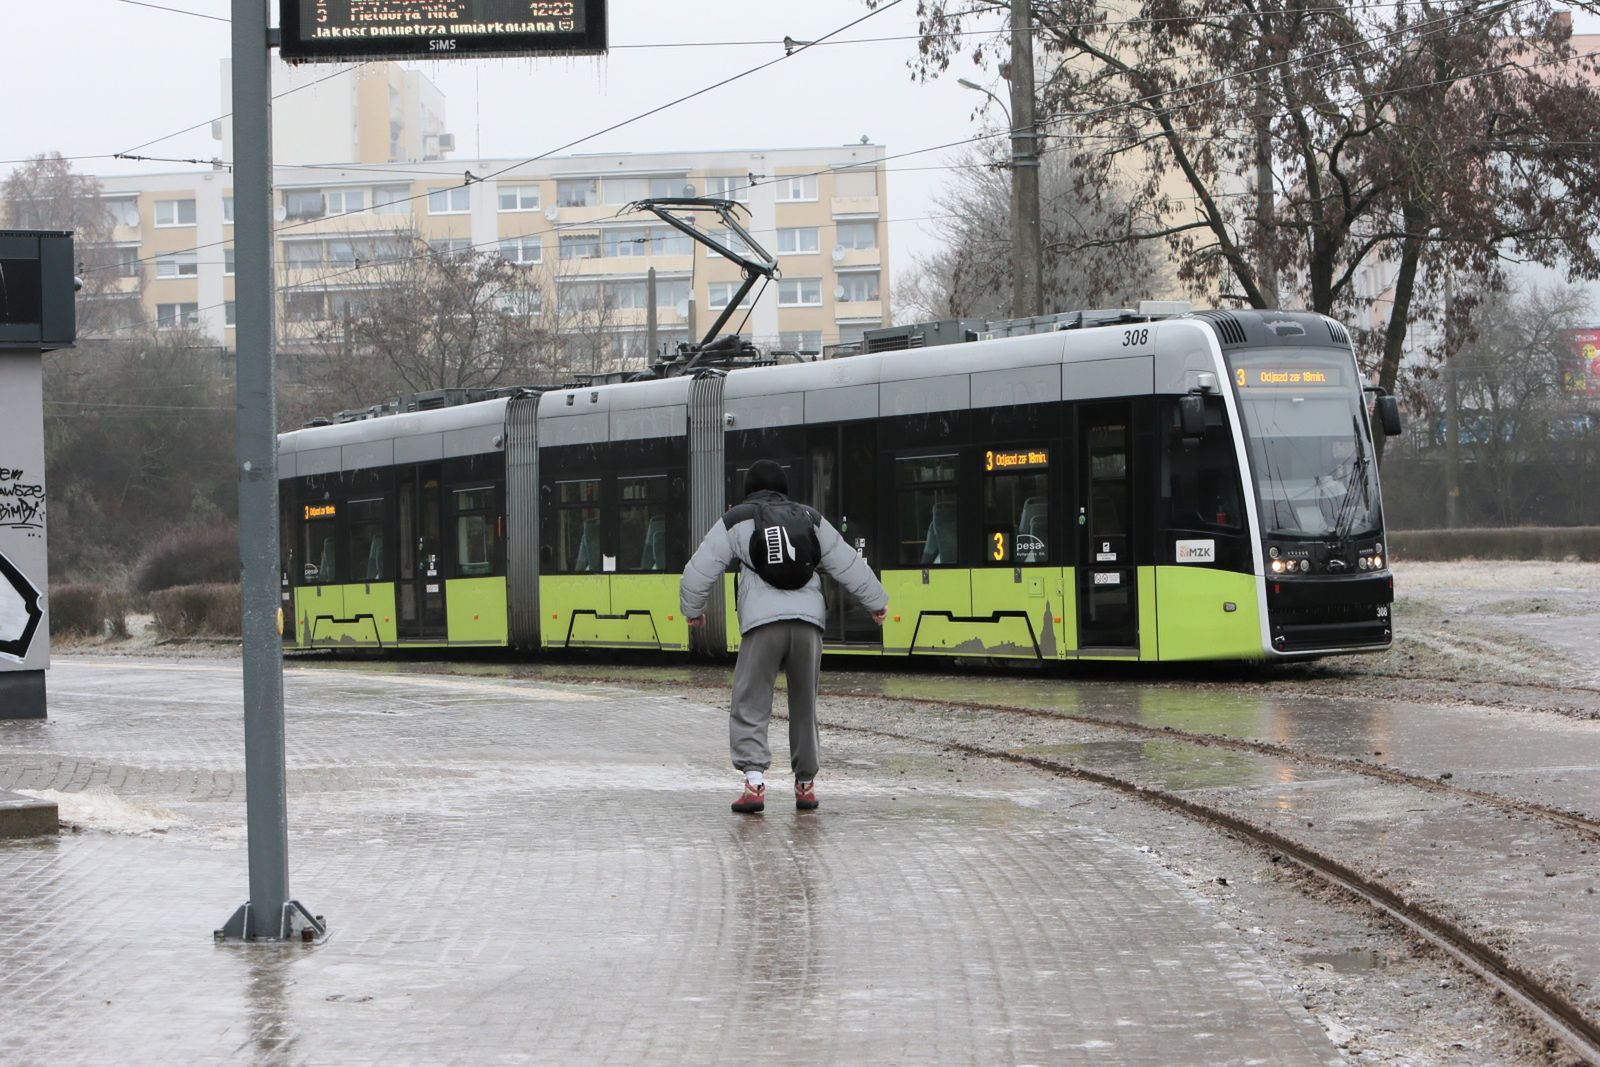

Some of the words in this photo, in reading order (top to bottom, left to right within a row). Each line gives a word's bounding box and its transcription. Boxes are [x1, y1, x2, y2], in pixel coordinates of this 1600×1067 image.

[429, 39, 456, 50] SiMS
[1122, 328, 1148, 346] 308
[1236, 368, 1246, 386] 3
[986, 450, 993, 471] 3
[766, 528, 781, 562] PUMA
[993, 532, 1004, 561] 3
[1016, 542, 1042, 552] pesa
[1189, 547, 1211, 557] MZK
[1376, 606, 1388, 617] 308
